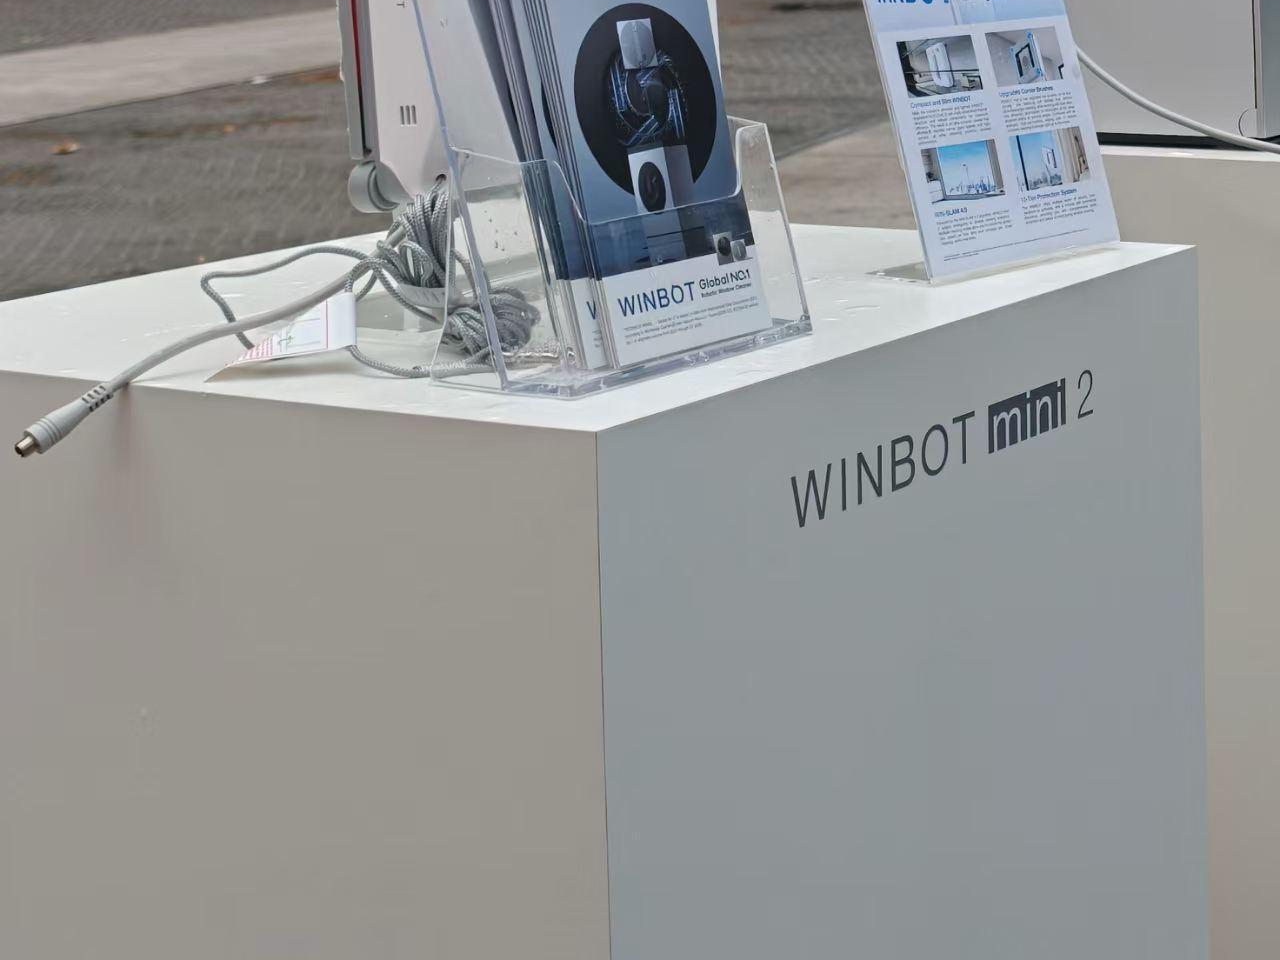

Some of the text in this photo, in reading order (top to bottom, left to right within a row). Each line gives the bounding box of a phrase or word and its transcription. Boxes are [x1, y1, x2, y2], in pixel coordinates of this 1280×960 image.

[617, 281, 695, 317] WINBOT
[699, 273, 729, 289] Global
[790, 369, 1094, 528] WINBOT mini 2
